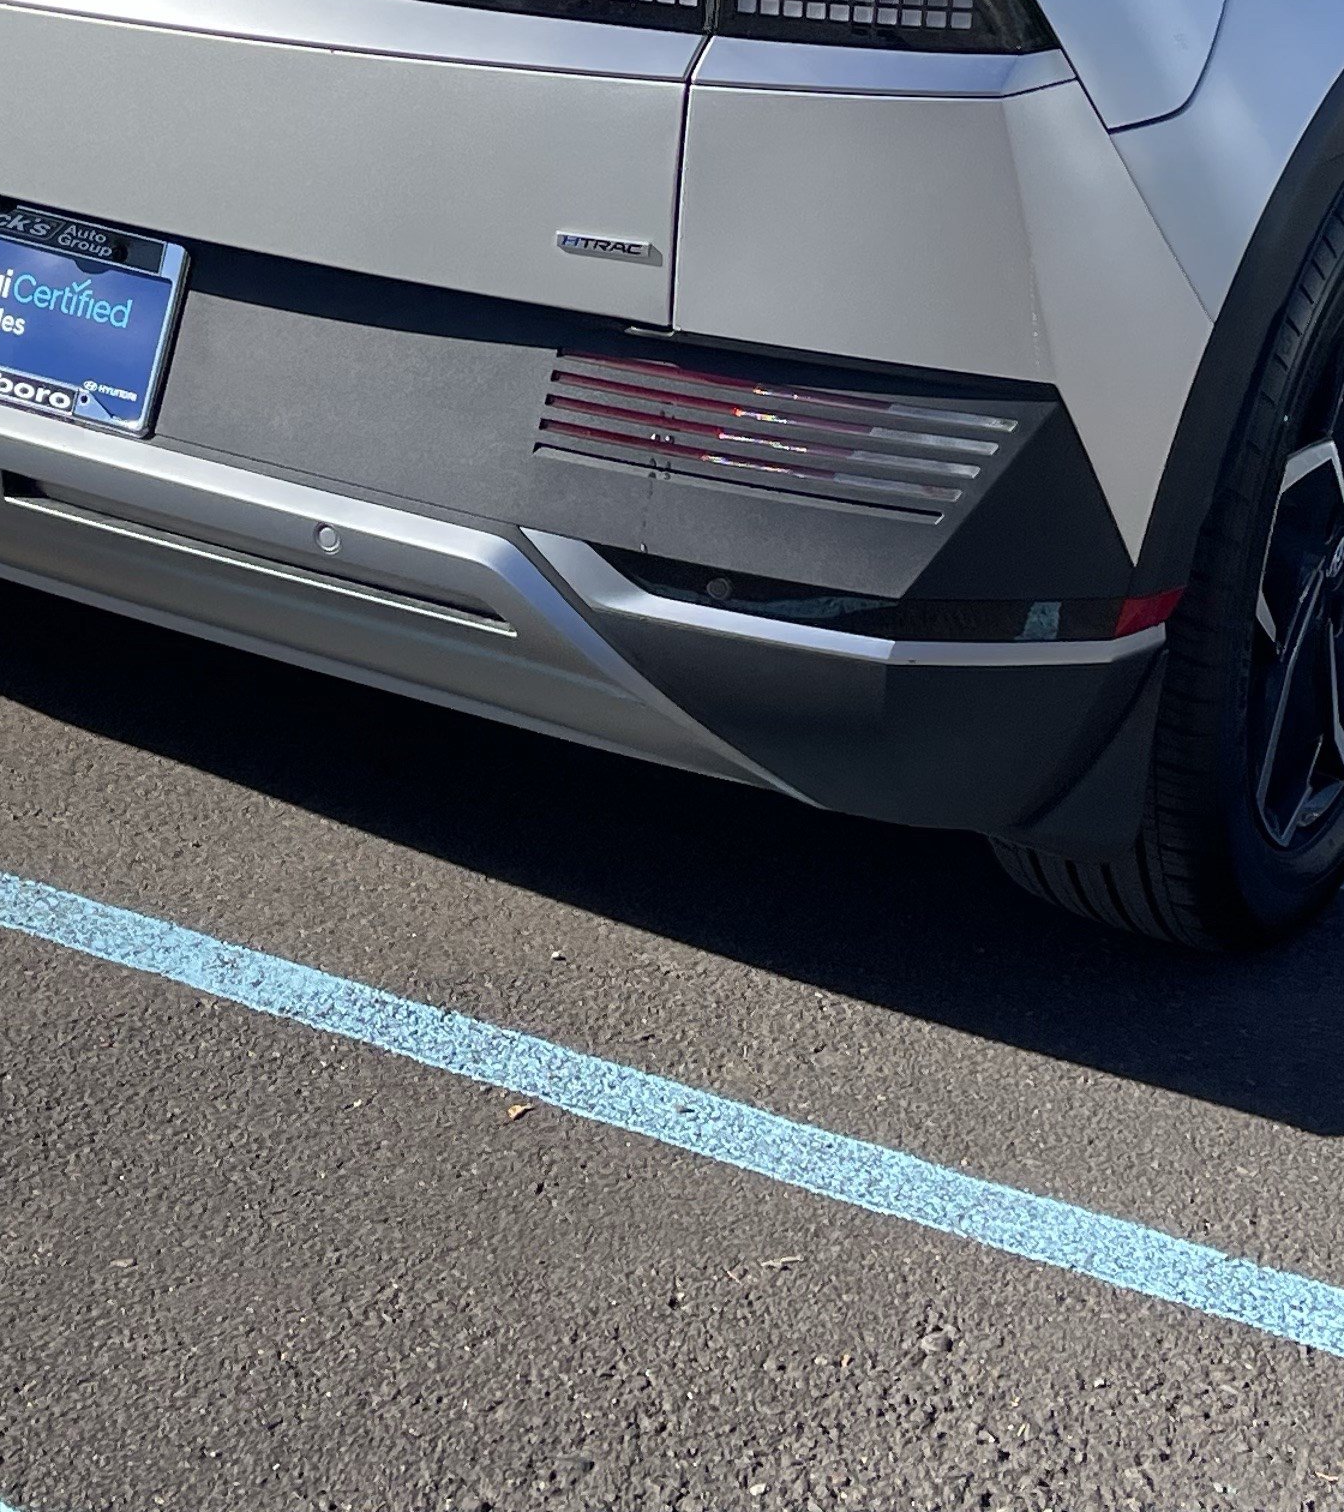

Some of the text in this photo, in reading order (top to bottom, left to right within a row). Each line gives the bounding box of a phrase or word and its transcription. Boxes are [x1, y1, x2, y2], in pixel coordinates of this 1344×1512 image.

[64, 224, 107, 243] Auto
[562, 234, 643, 255] HTRAC
[57, 233, 113, 257] Group
[12, 273, 133, 329] Certified
